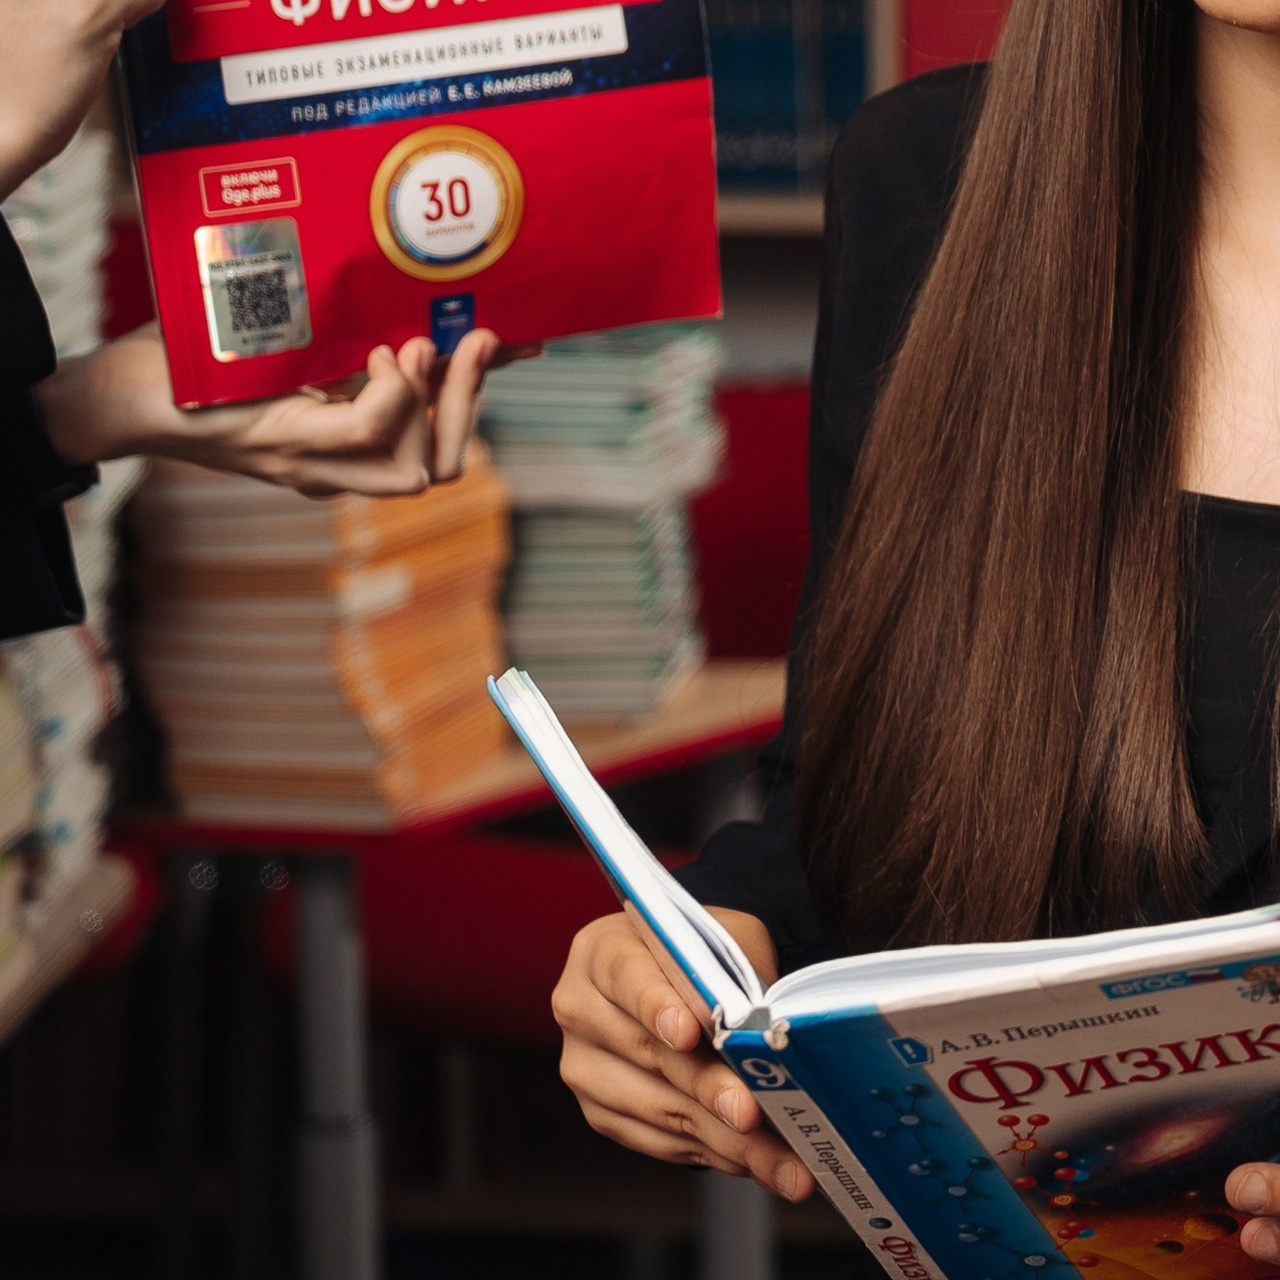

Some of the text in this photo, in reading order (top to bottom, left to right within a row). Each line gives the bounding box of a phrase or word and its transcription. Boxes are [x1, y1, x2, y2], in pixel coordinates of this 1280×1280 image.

[244, 26, 604, 88] ТИПОВЫЕ ЭКЗАМЕНАЦИОННЫЕ ВАРИАНТЫ
[291, 105, 329, 122] ПОД
[335, 87, 442, 118] РЕДАКЦИЕЙ
[420, 178, 471, 221] 30
[741, 1057, 786, 1089] 9
[811, 1140, 873, 1211] Перышкин
